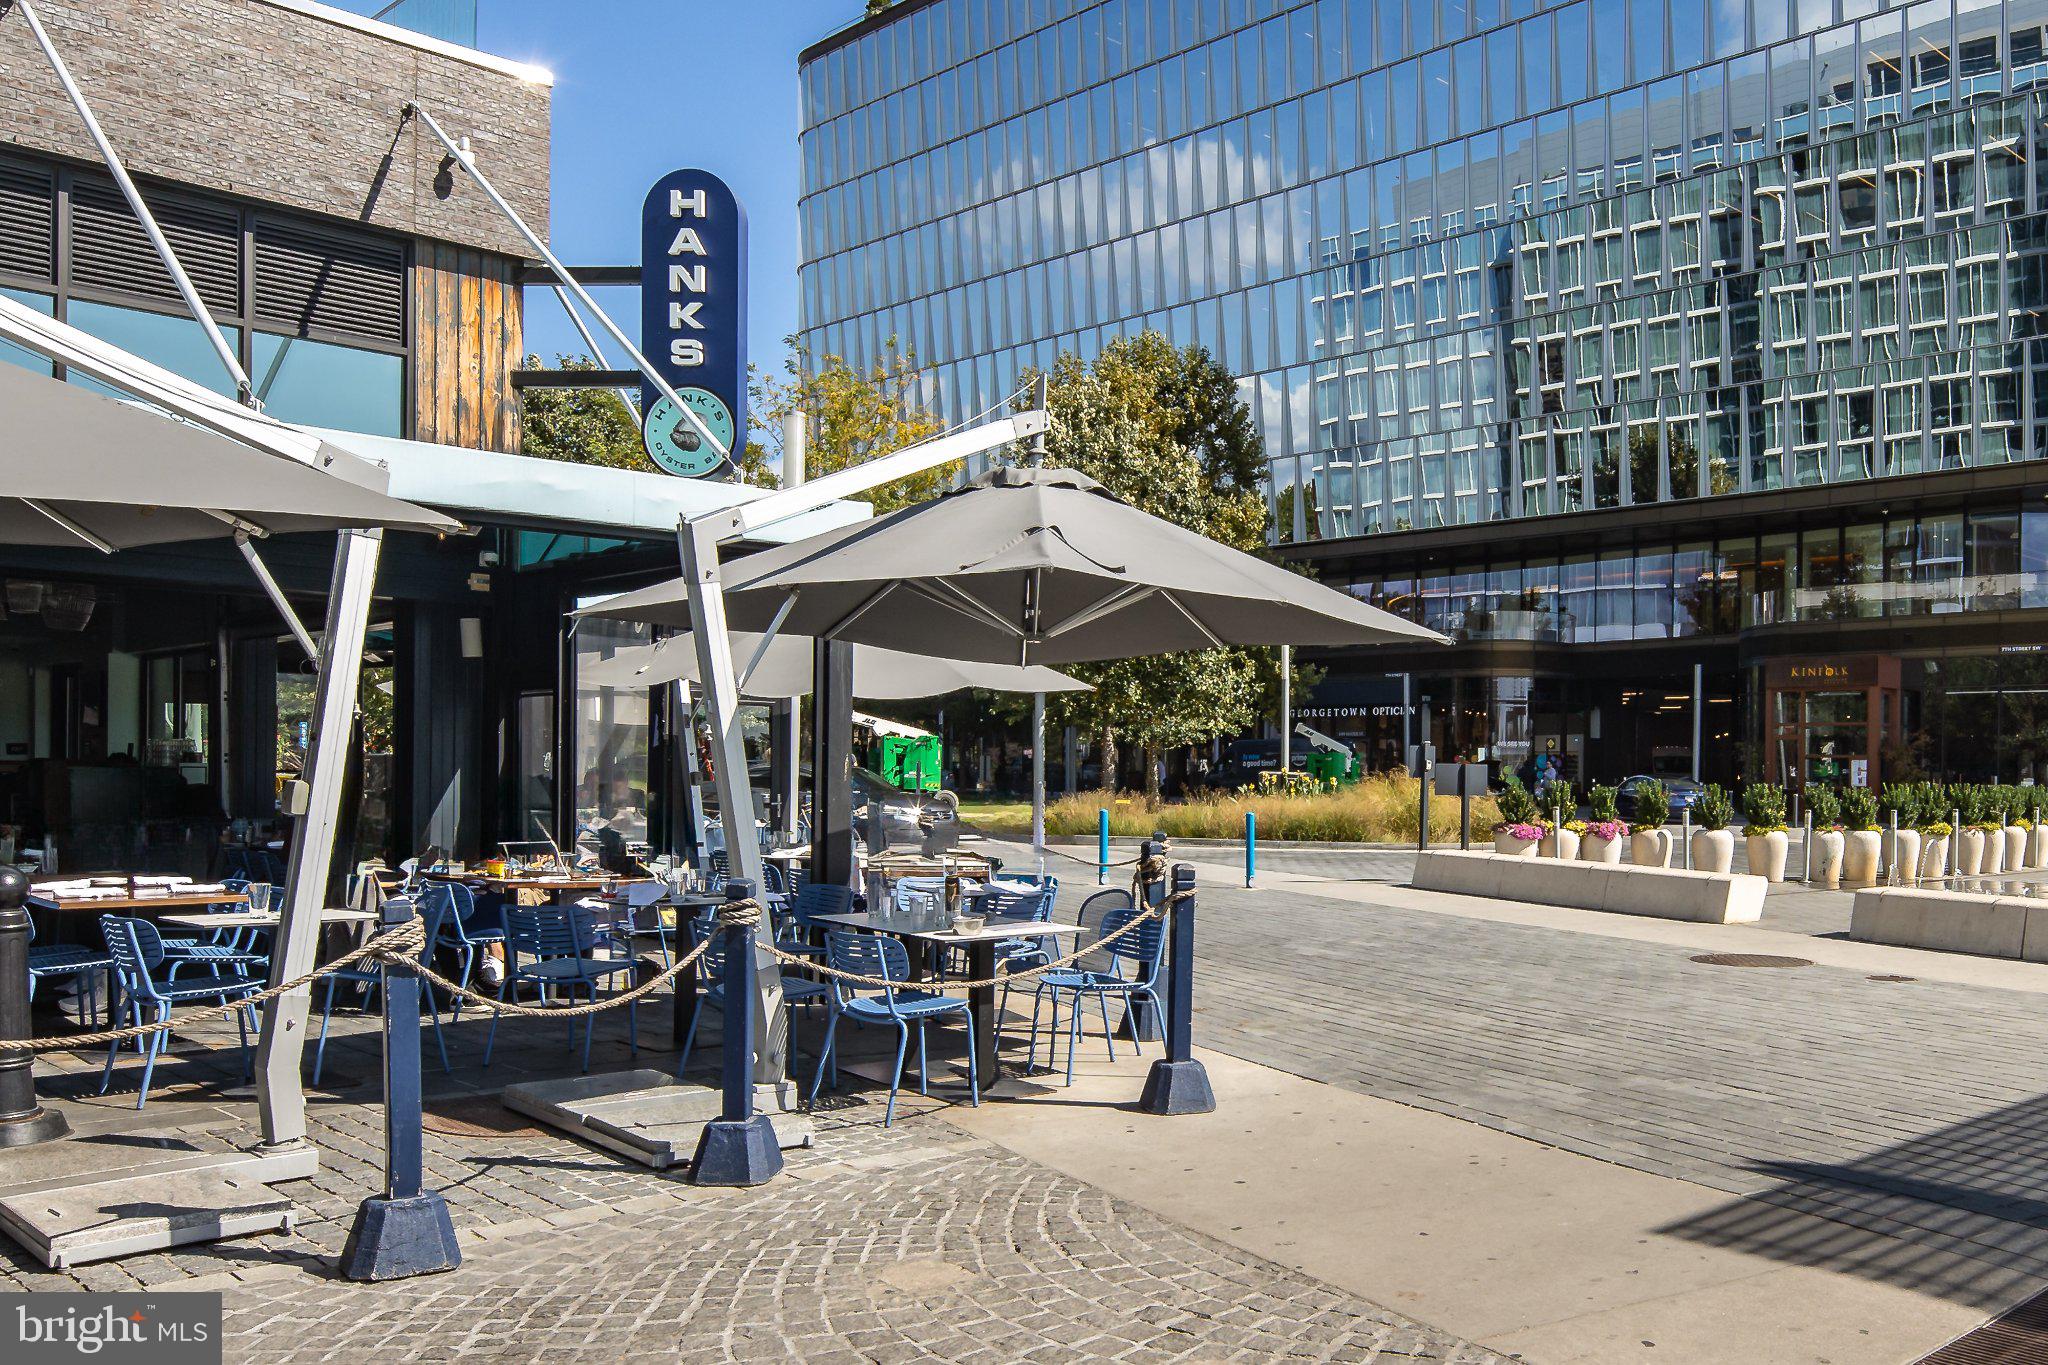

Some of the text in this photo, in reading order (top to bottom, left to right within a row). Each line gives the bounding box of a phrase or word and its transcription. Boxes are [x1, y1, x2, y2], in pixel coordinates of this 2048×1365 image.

[667, 189, 707, 367] HANKS
[655, 442, 696, 470] OYSTER
[1290, 706, 1416, 718] GEORGETOWN OPTICIN
[1246, 759, 1261, 768] good
